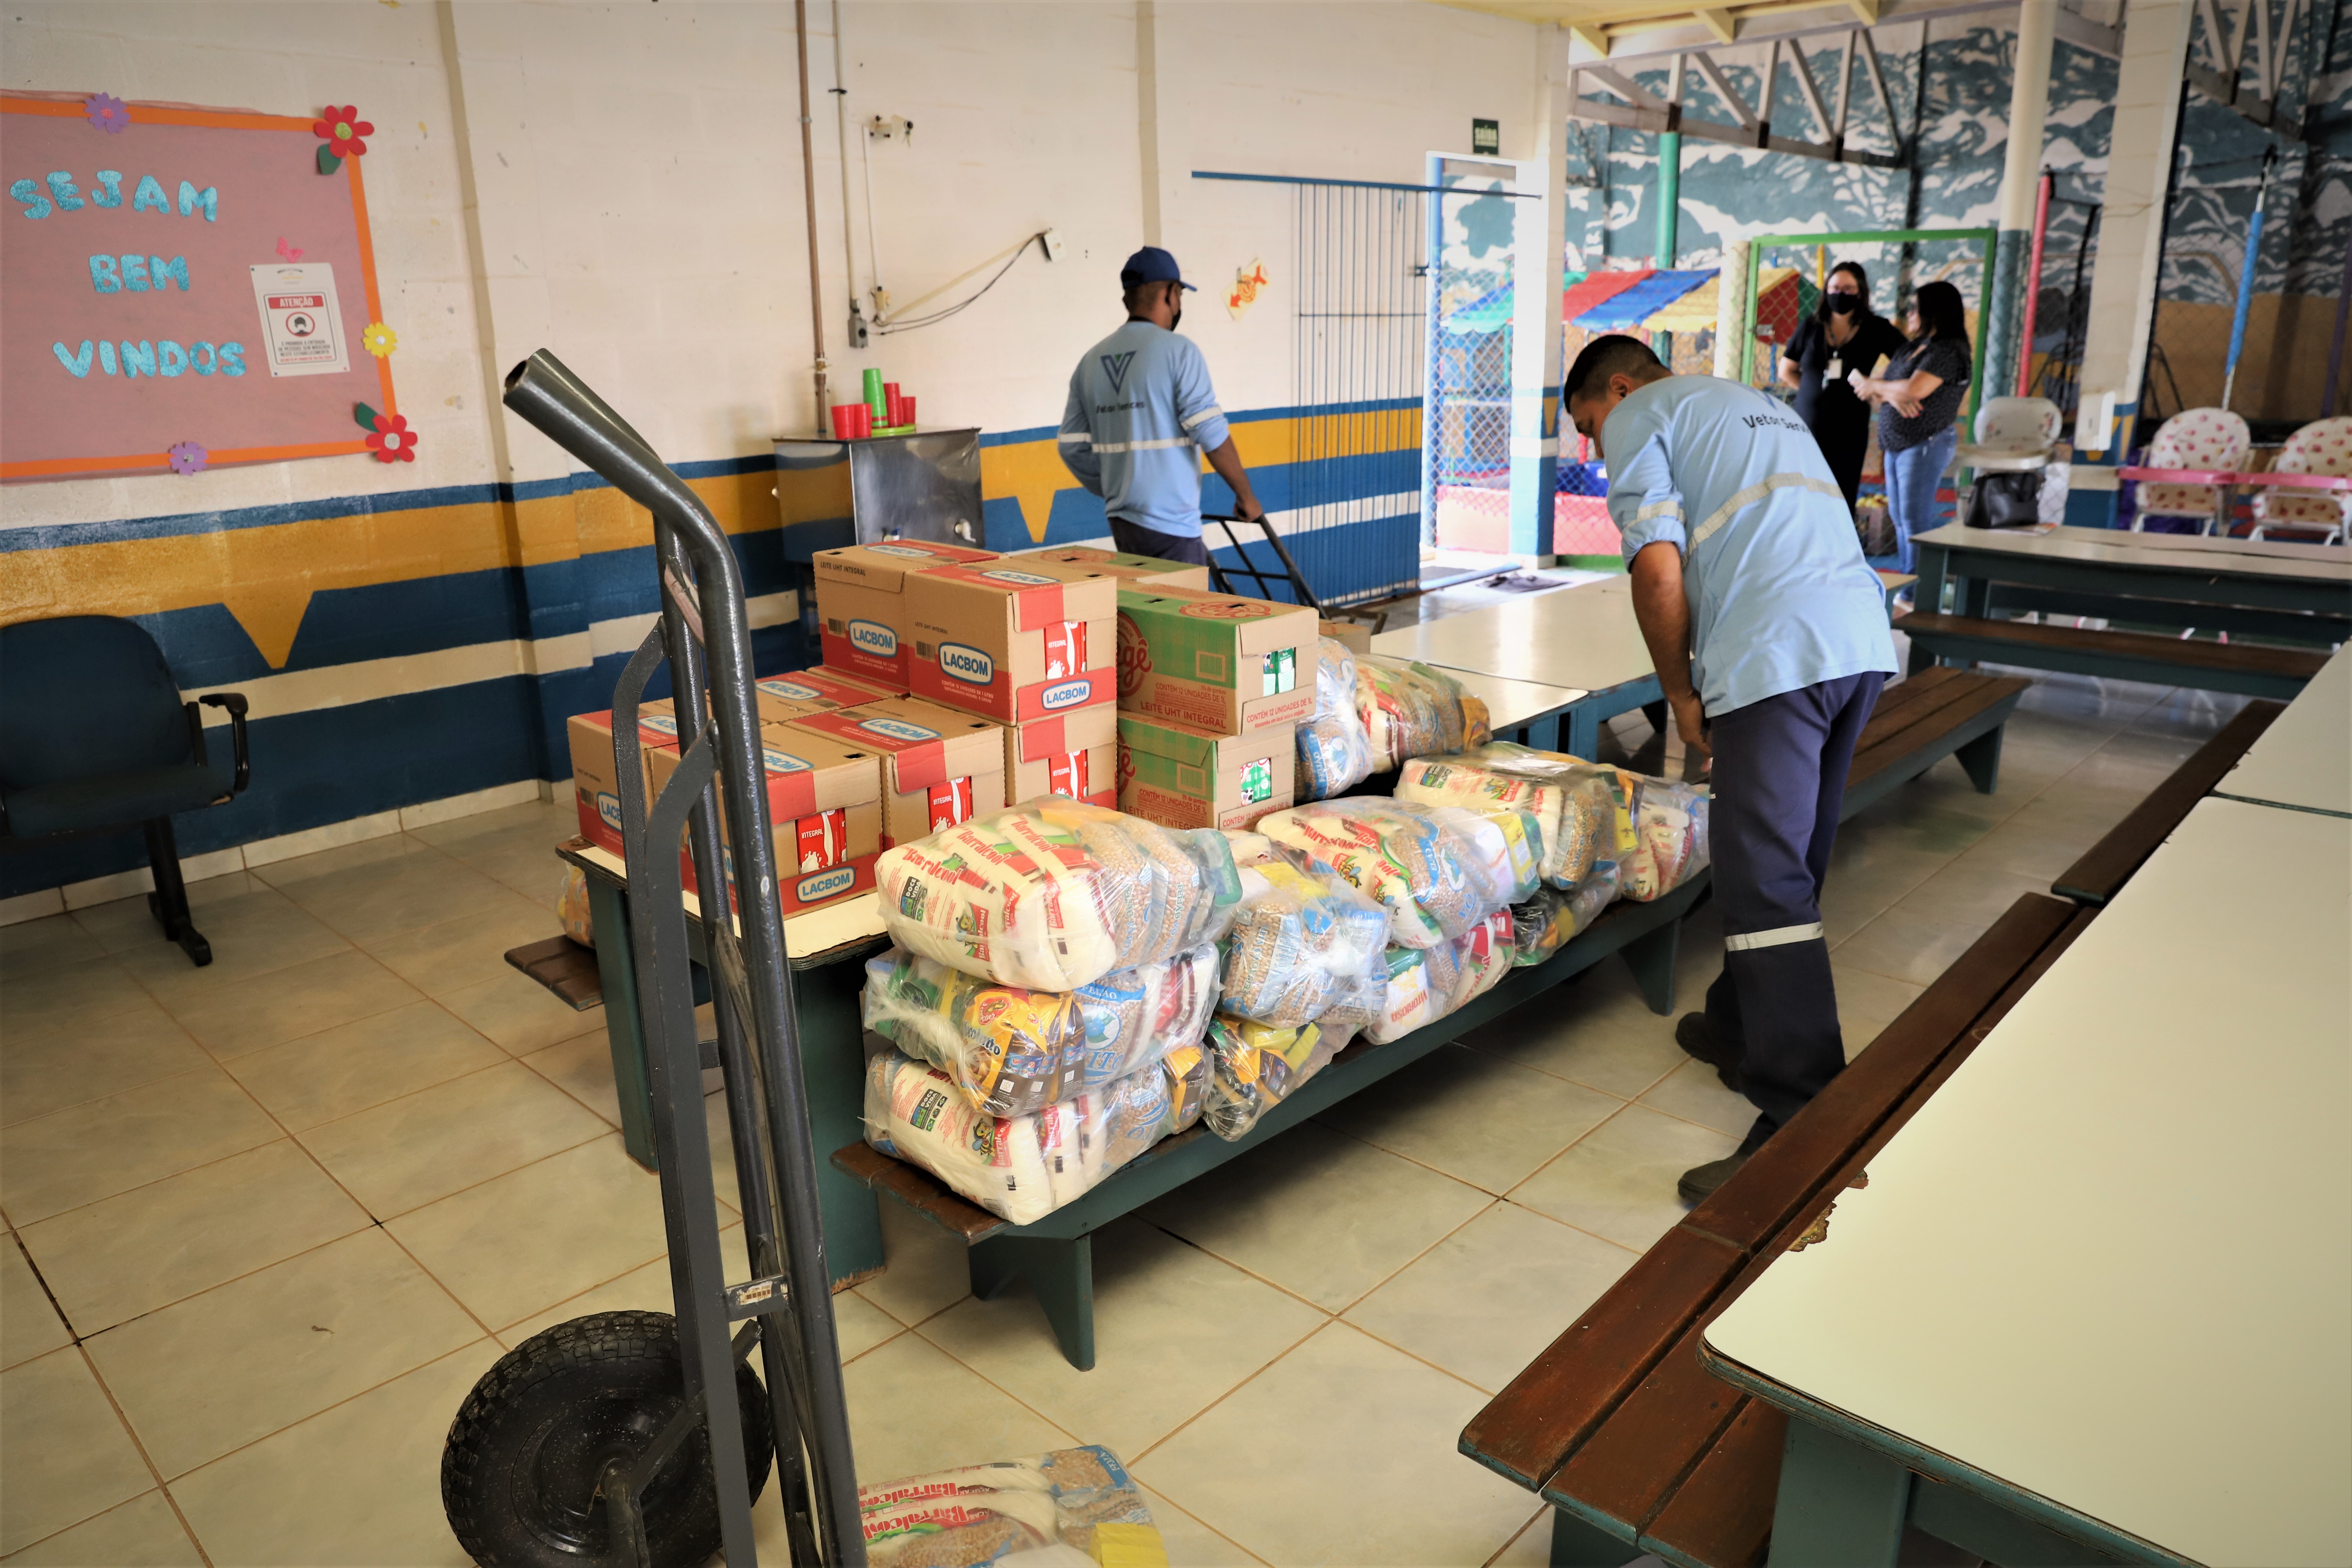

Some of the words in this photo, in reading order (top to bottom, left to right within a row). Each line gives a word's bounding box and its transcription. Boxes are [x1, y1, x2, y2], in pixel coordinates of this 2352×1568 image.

[10, 170, 217, 222] SEJAM
[89, 254, 190, 293] BEM
[280, 296, 314, 308] ATENÇÃO
[53, 340, 246, 378] VINDOS
[1742, 414, 1780, 428] Vetor
[844, 567, 866, 576] INTEGRAL
[854, 628, 893, 649] LACBOM
[931, 626, 948, 635] INTEGRAL
[1048, 639, 1067, 649] INTEGRAL
[944, 651, 988, 677] LACBOM
[1047, 686, 1086, 704] LACBOM
[1156, 682, 1177, 693] CONTÉM
[1185, 688, 1211, 701] UNIDADES
[1141, 701, 1162, 714] LEITE
[1165, 706, 1181, 717] UHT
[1184, 711, 1226, 729] INTEGRAL
[1246, 710, 1268, 723] CONTÉM
[1275, 702, 1299, 715] UNIDADES
[868, 720, 930, 739] LACBOM
[1053, 767, 1070, 777] INTEGRAL
[933, 795, 952, 805] INTEGRAL
[1139, 789, 1160, 801] CONTÉM
[1167, 796, 1193, 810] UNIDADES
[1194, 803, 1201, 812] DE
[1125, 805, 1145, 818] LEITE
[1147, 811, 1163, 823] UHT
[1223, 814, 1244, 827] CONTÉM
[1252, 805, 1277, 818] UNIDADES
[801, 828, 823, 839] INTEGRAL
[1011, 819, 1060, 852] Barralcool
[957, 830, 1012, 866] Barralcool
[802, 873, 850, 897] LACBOM
[905, 878, 917, 897] DOCE
[911, 881, 922, 899] VIDA
[1241, 961, 1259, 995] FEIJÃO
[1391, 989, 1427, 1023] VITORIOSA
[920, 1090, 934, 1107] DOCE
[924, 1092, 938, 1109] VIDA
